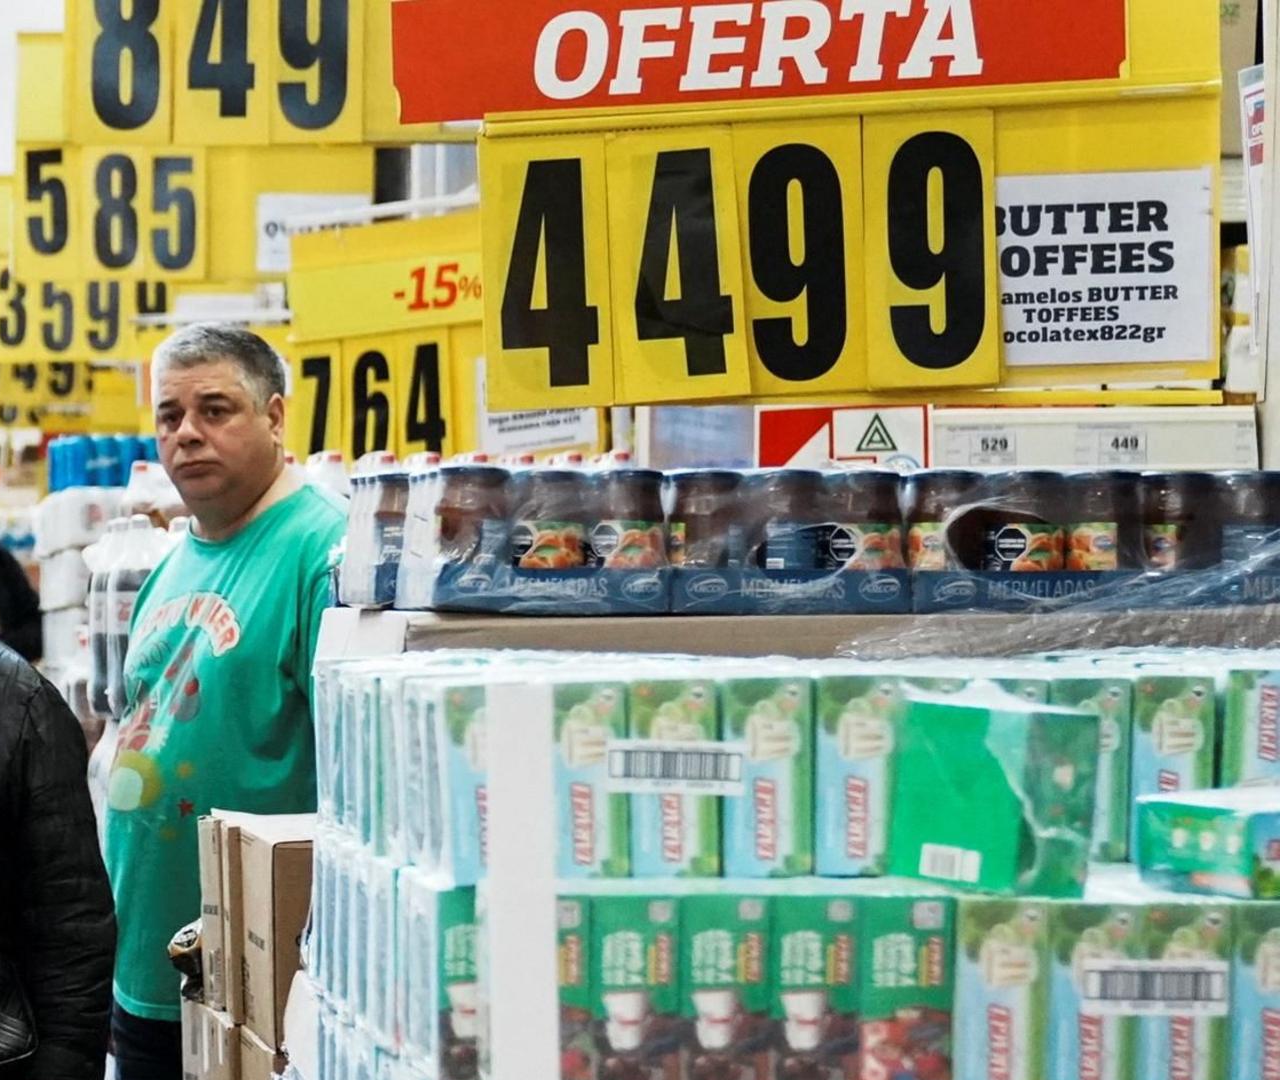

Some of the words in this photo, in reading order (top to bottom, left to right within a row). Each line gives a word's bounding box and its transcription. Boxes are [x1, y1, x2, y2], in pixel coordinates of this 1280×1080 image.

[533, 0, 985, 101] OFERTA
[26, 149, 197, 270] 585
[501, 130, 986, 388] 4499
[1000, 241, 1174, 277] OFFEES
[393, 263, 482, 311] -15%
[1088, 285, 1178, 302] BUTTER
[1023, 306, 1119, 323] TOFFEES
[301, 342, 446, 459] 764
[980, 437, 1008, 450] 529
[1110, 437, 1139, 451] 449
